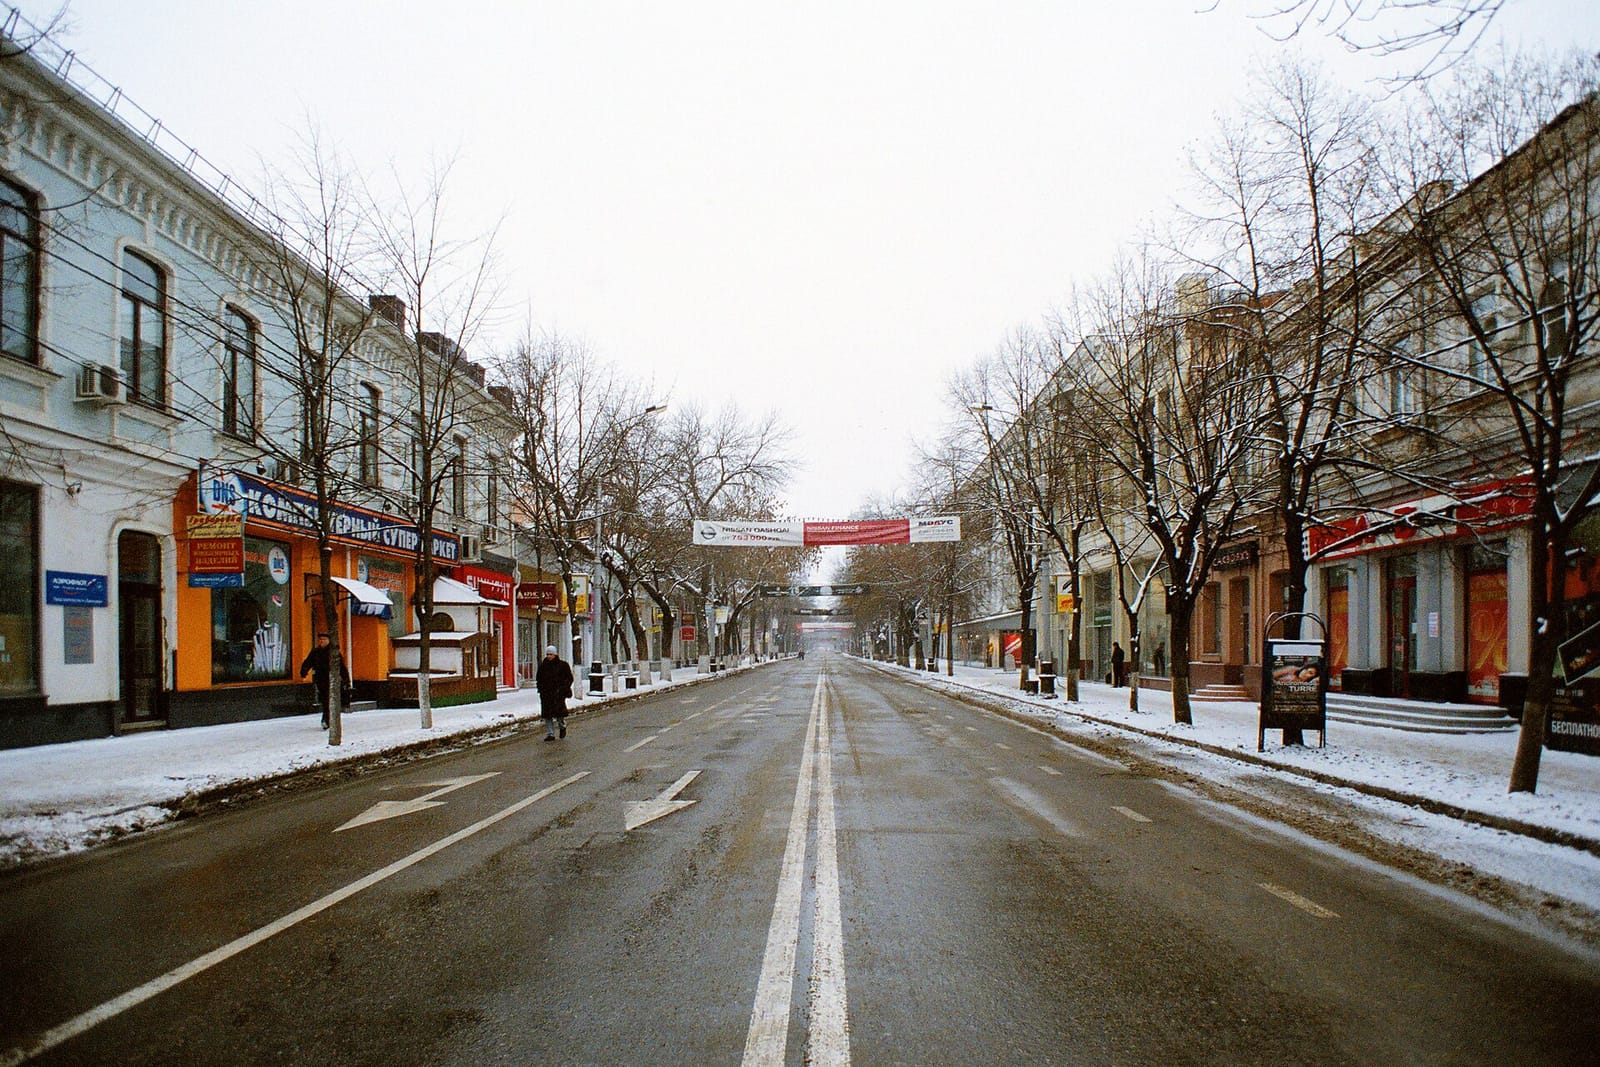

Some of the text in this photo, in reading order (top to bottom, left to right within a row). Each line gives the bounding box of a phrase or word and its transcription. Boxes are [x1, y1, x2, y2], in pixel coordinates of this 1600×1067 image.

[213, 479, 236, 506] DNS
[197, 542, 236, 550] РЕМОНТ
[195, 556, 238, 565] ИЗДЕЛИЙ
